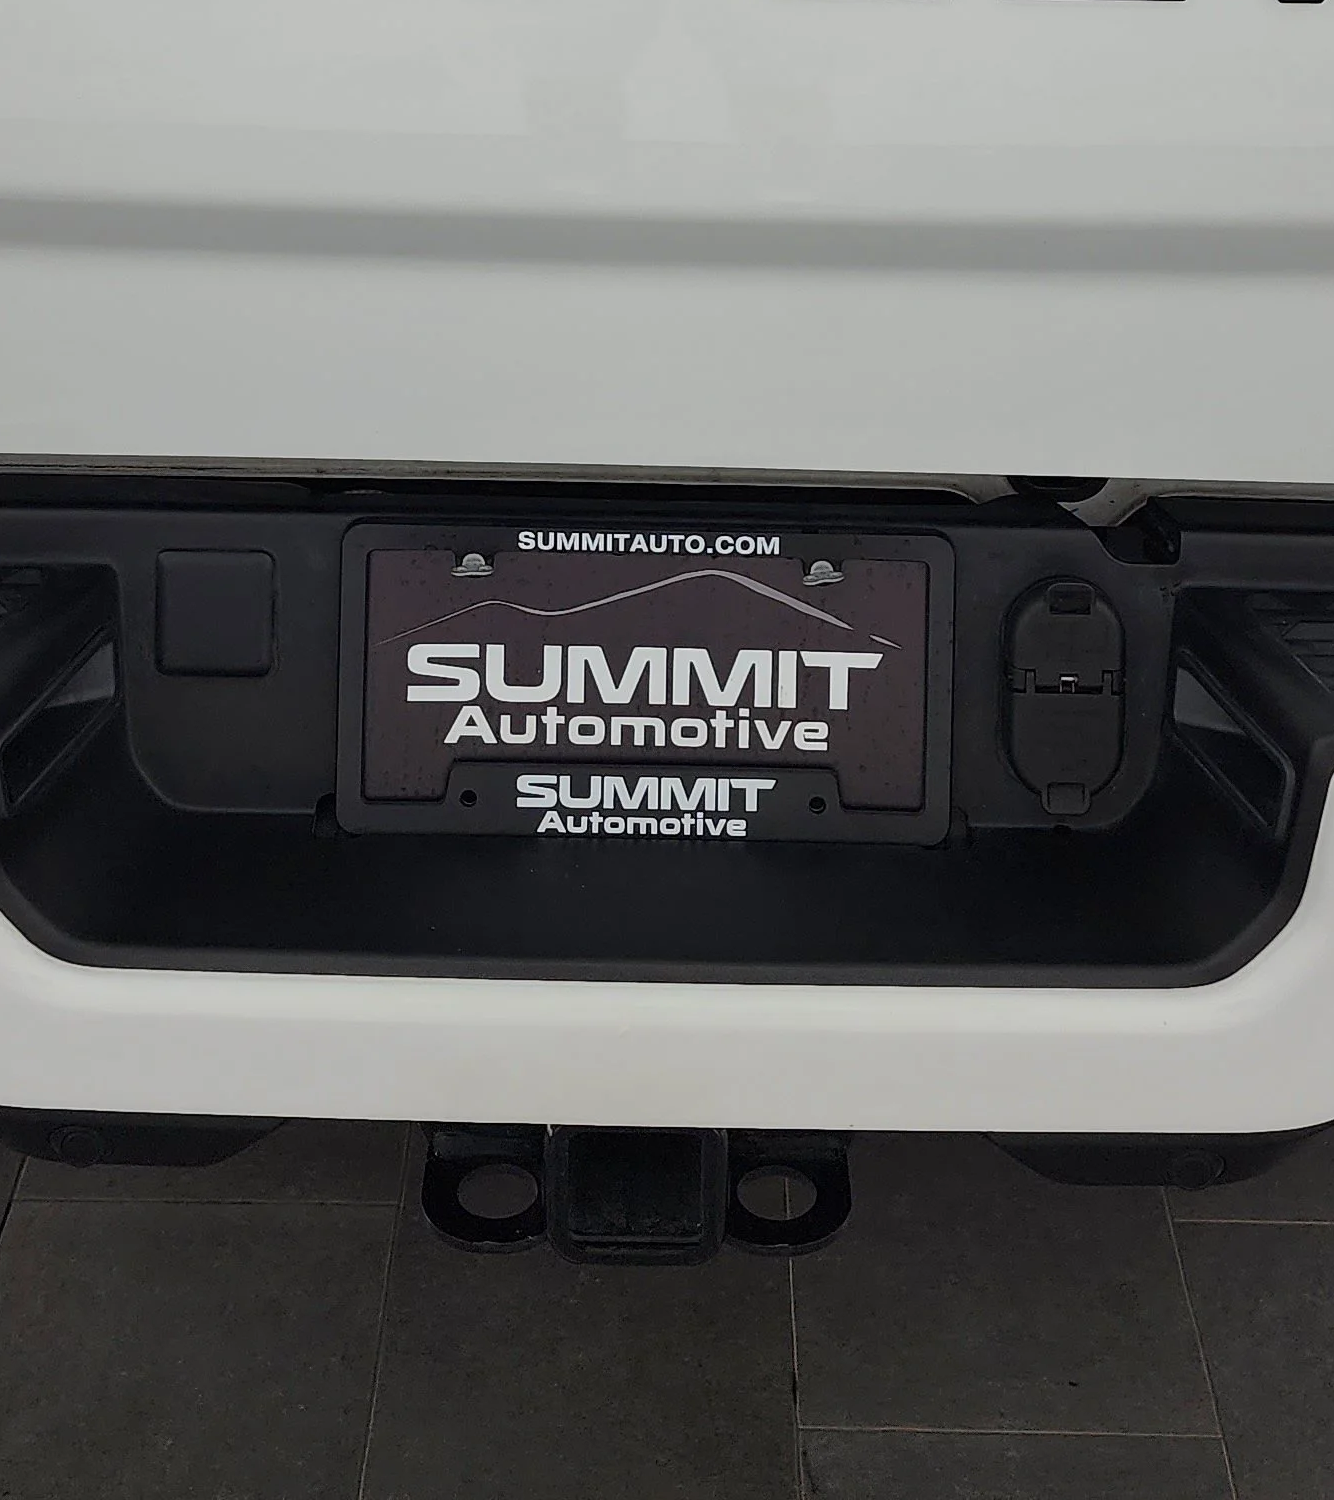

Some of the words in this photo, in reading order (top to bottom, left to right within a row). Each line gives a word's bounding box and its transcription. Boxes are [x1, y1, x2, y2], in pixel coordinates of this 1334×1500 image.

[517, 530, 781, 556] SUMMITAUTO.COM
[406, 643, 884, 711] SUMMIT
[443, 705, 829, 752] Automotive
[516, 774, 777, 813] SUMMIT
[536, 809, 748, 838] Automotive
